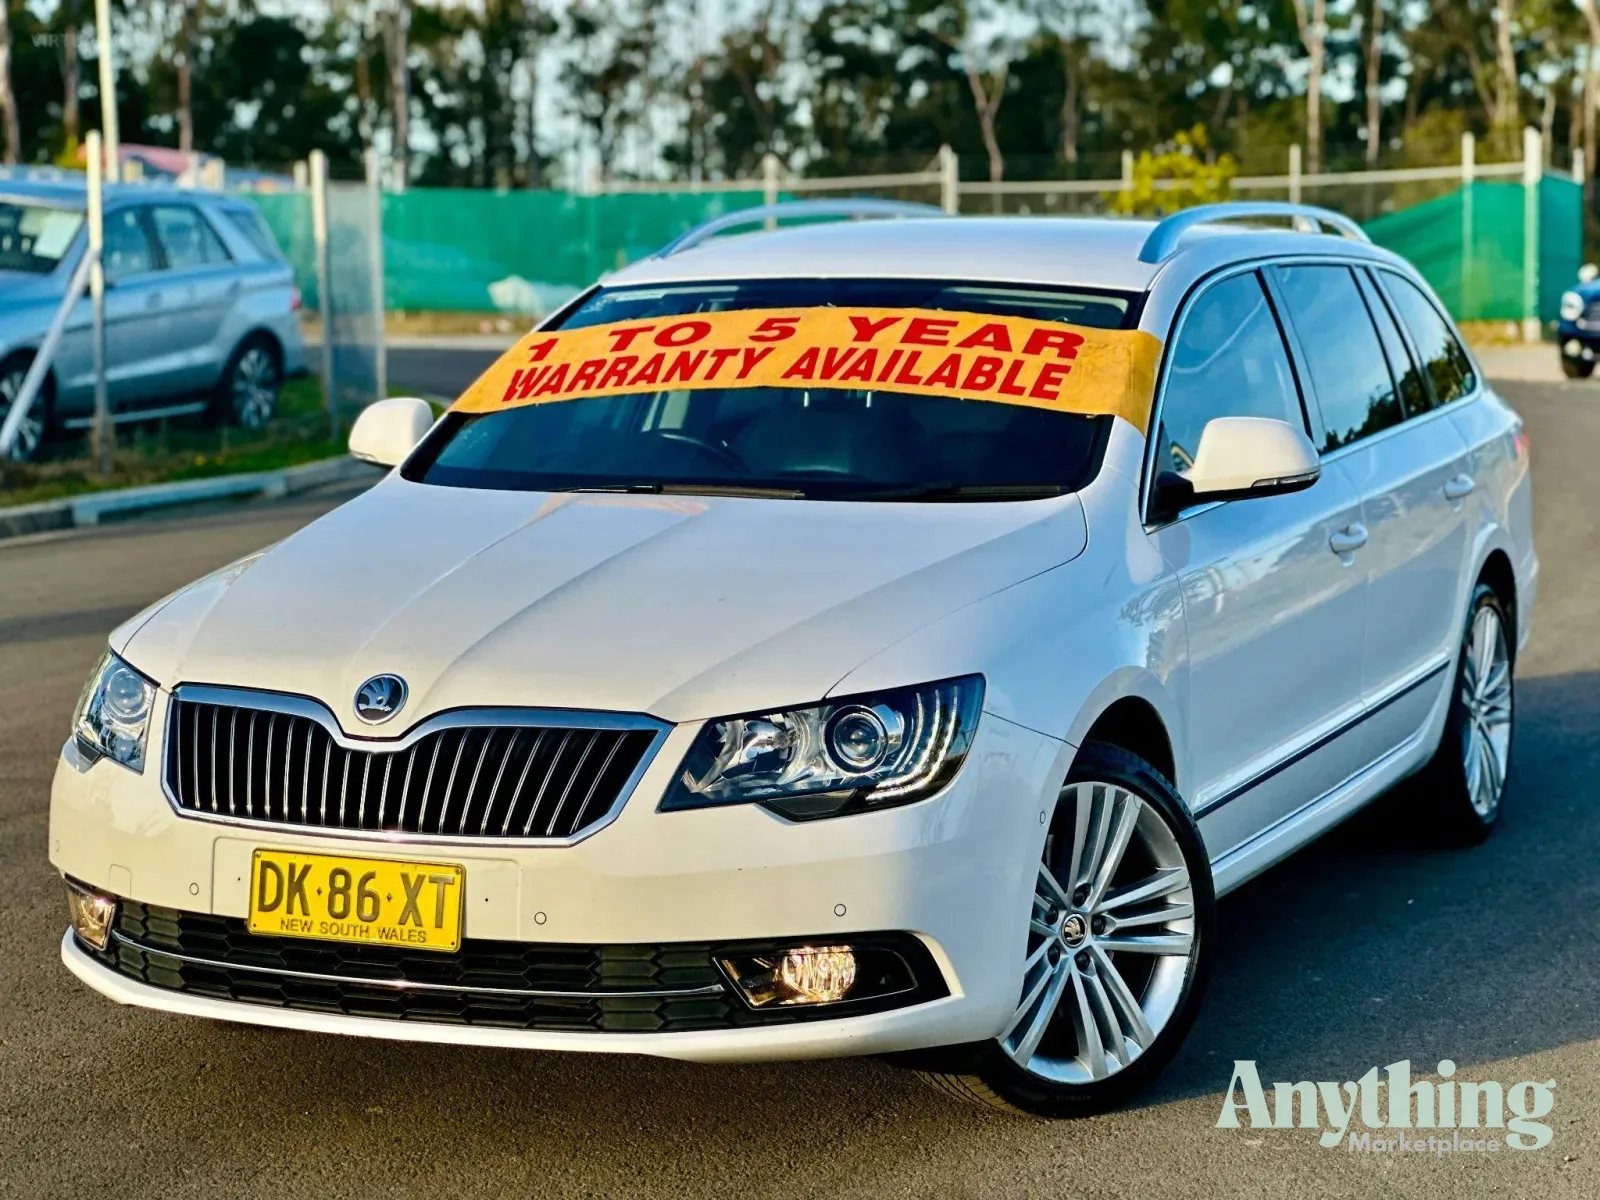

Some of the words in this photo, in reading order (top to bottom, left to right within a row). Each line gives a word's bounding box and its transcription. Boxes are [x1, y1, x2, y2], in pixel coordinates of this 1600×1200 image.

[528, 338, 559, 363] 1
[608, 320, 713, 353] TO
[748, 317, 802, 343] 5
[848, 316, 1086, 361] YEAR
[501, 346, 776, 402] WARRANTY
[780, 346, 1073, 402] AVAILABLE
[280, 917, 314, 933] NEW
[319, 920, 371, 938] SOUTH
[377, 926, 428, 944] WALES
